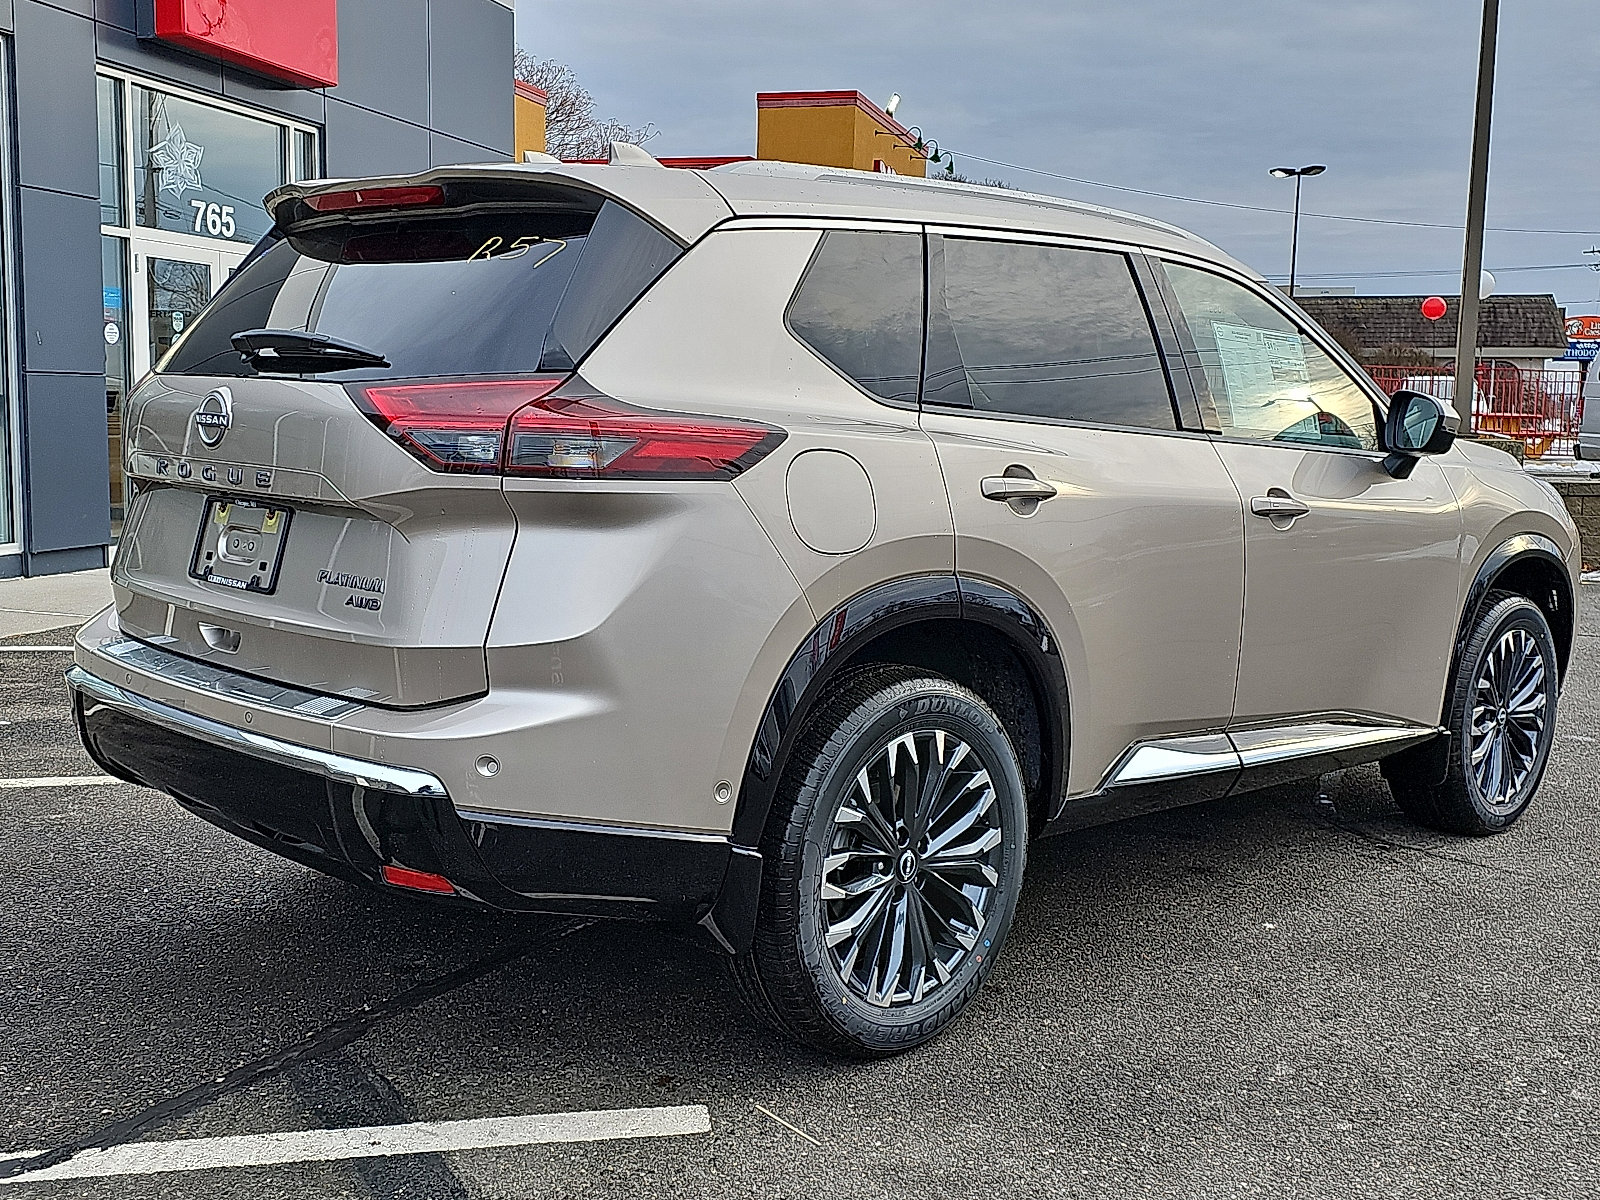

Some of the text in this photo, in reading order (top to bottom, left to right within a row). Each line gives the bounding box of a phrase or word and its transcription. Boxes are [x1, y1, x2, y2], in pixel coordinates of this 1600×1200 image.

[190, 199, 236, 238] 765
[195, 412, 229, 427] NISSAN
[156, 458, 272, 487] ROGUE
[317, 569, 386, 594] PLATINUM
[344, 594, 381, 611] AWD
[914, 694, 995, 734] DUNLOP
